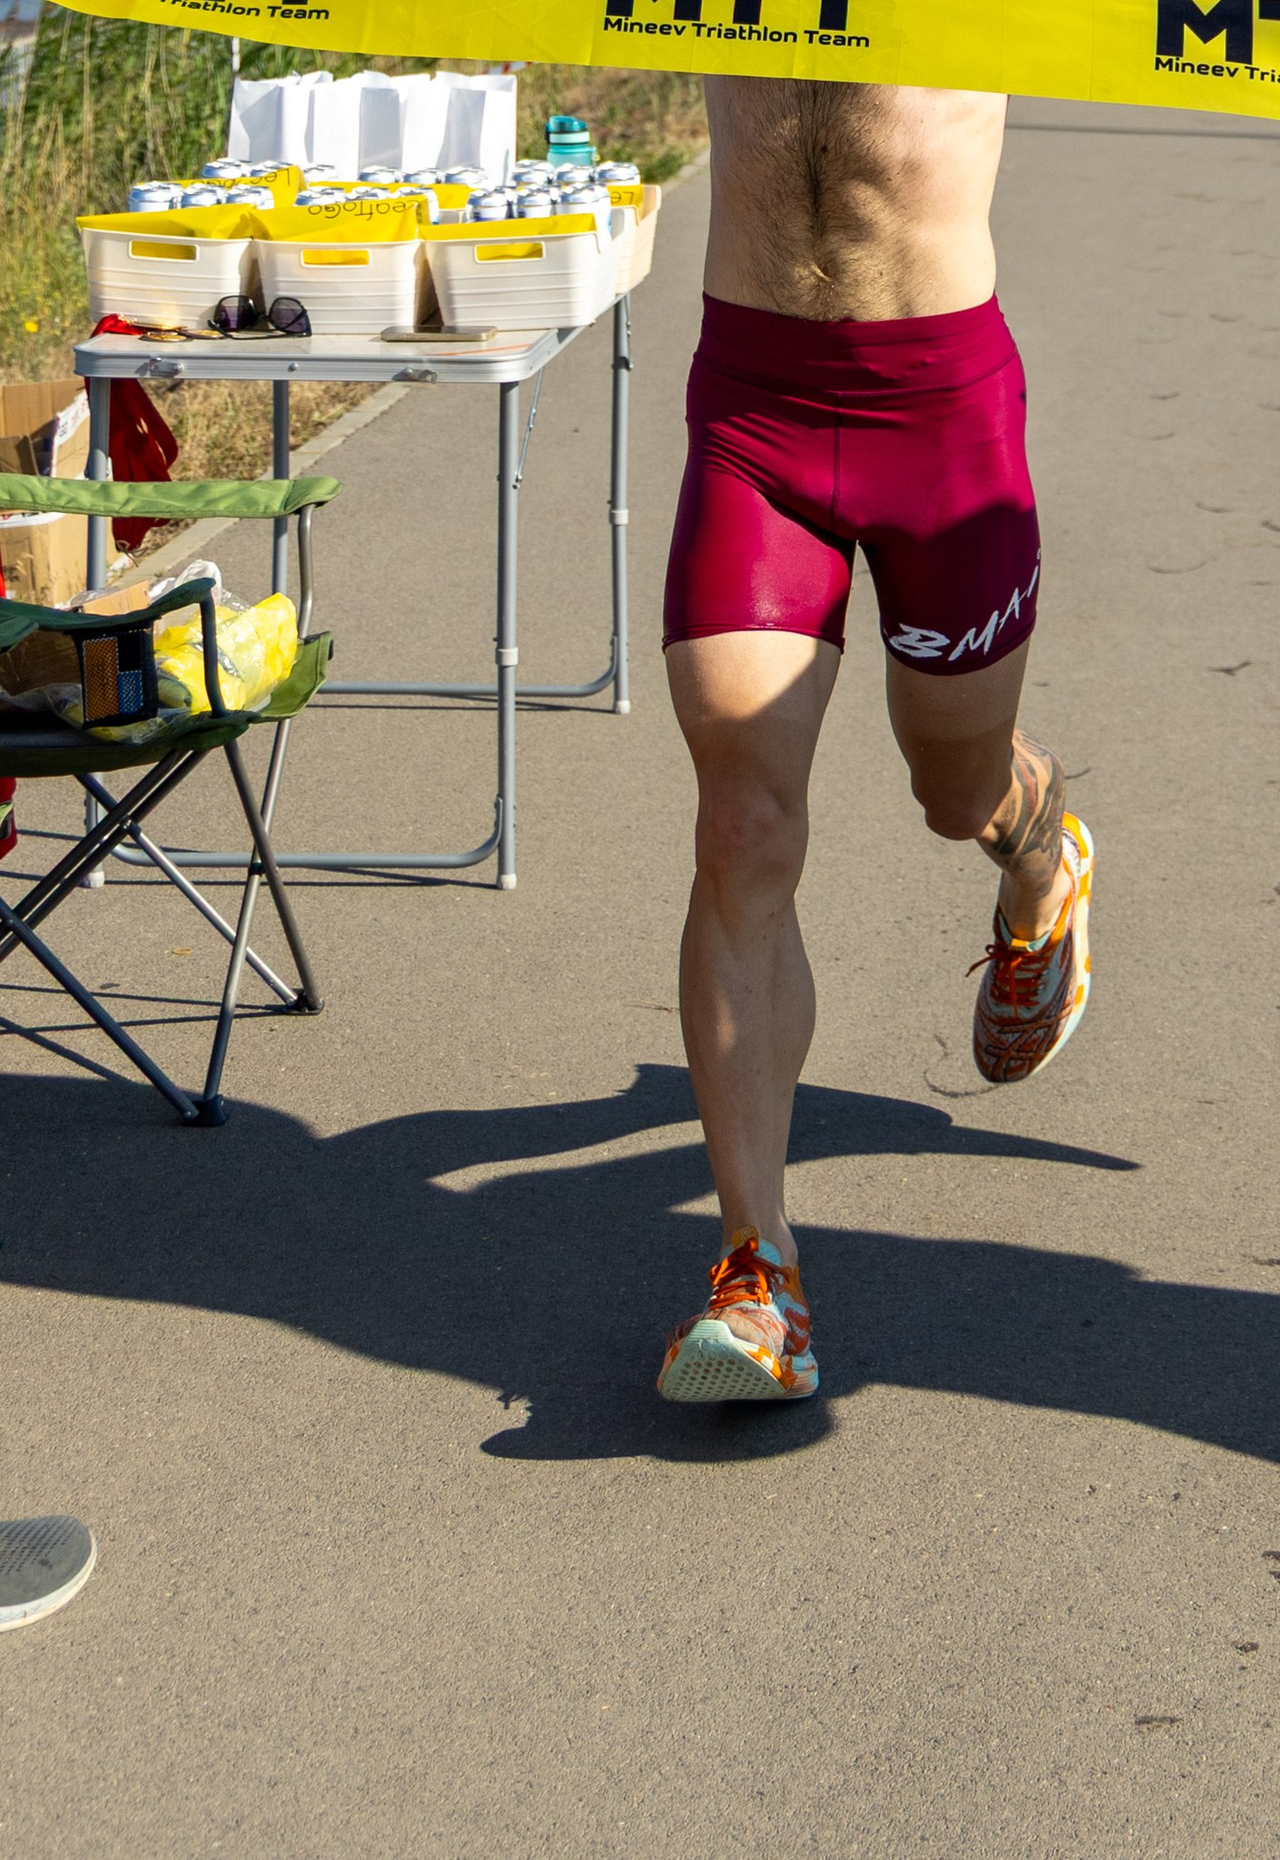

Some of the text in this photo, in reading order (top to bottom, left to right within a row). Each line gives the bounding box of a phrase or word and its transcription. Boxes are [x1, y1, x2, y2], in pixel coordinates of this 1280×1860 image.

[266, 5, 330, 20] Team
[603, 16, 870, 48] Mineev Triathlon Team
[1154, 57, 1239, 78] Mineev
